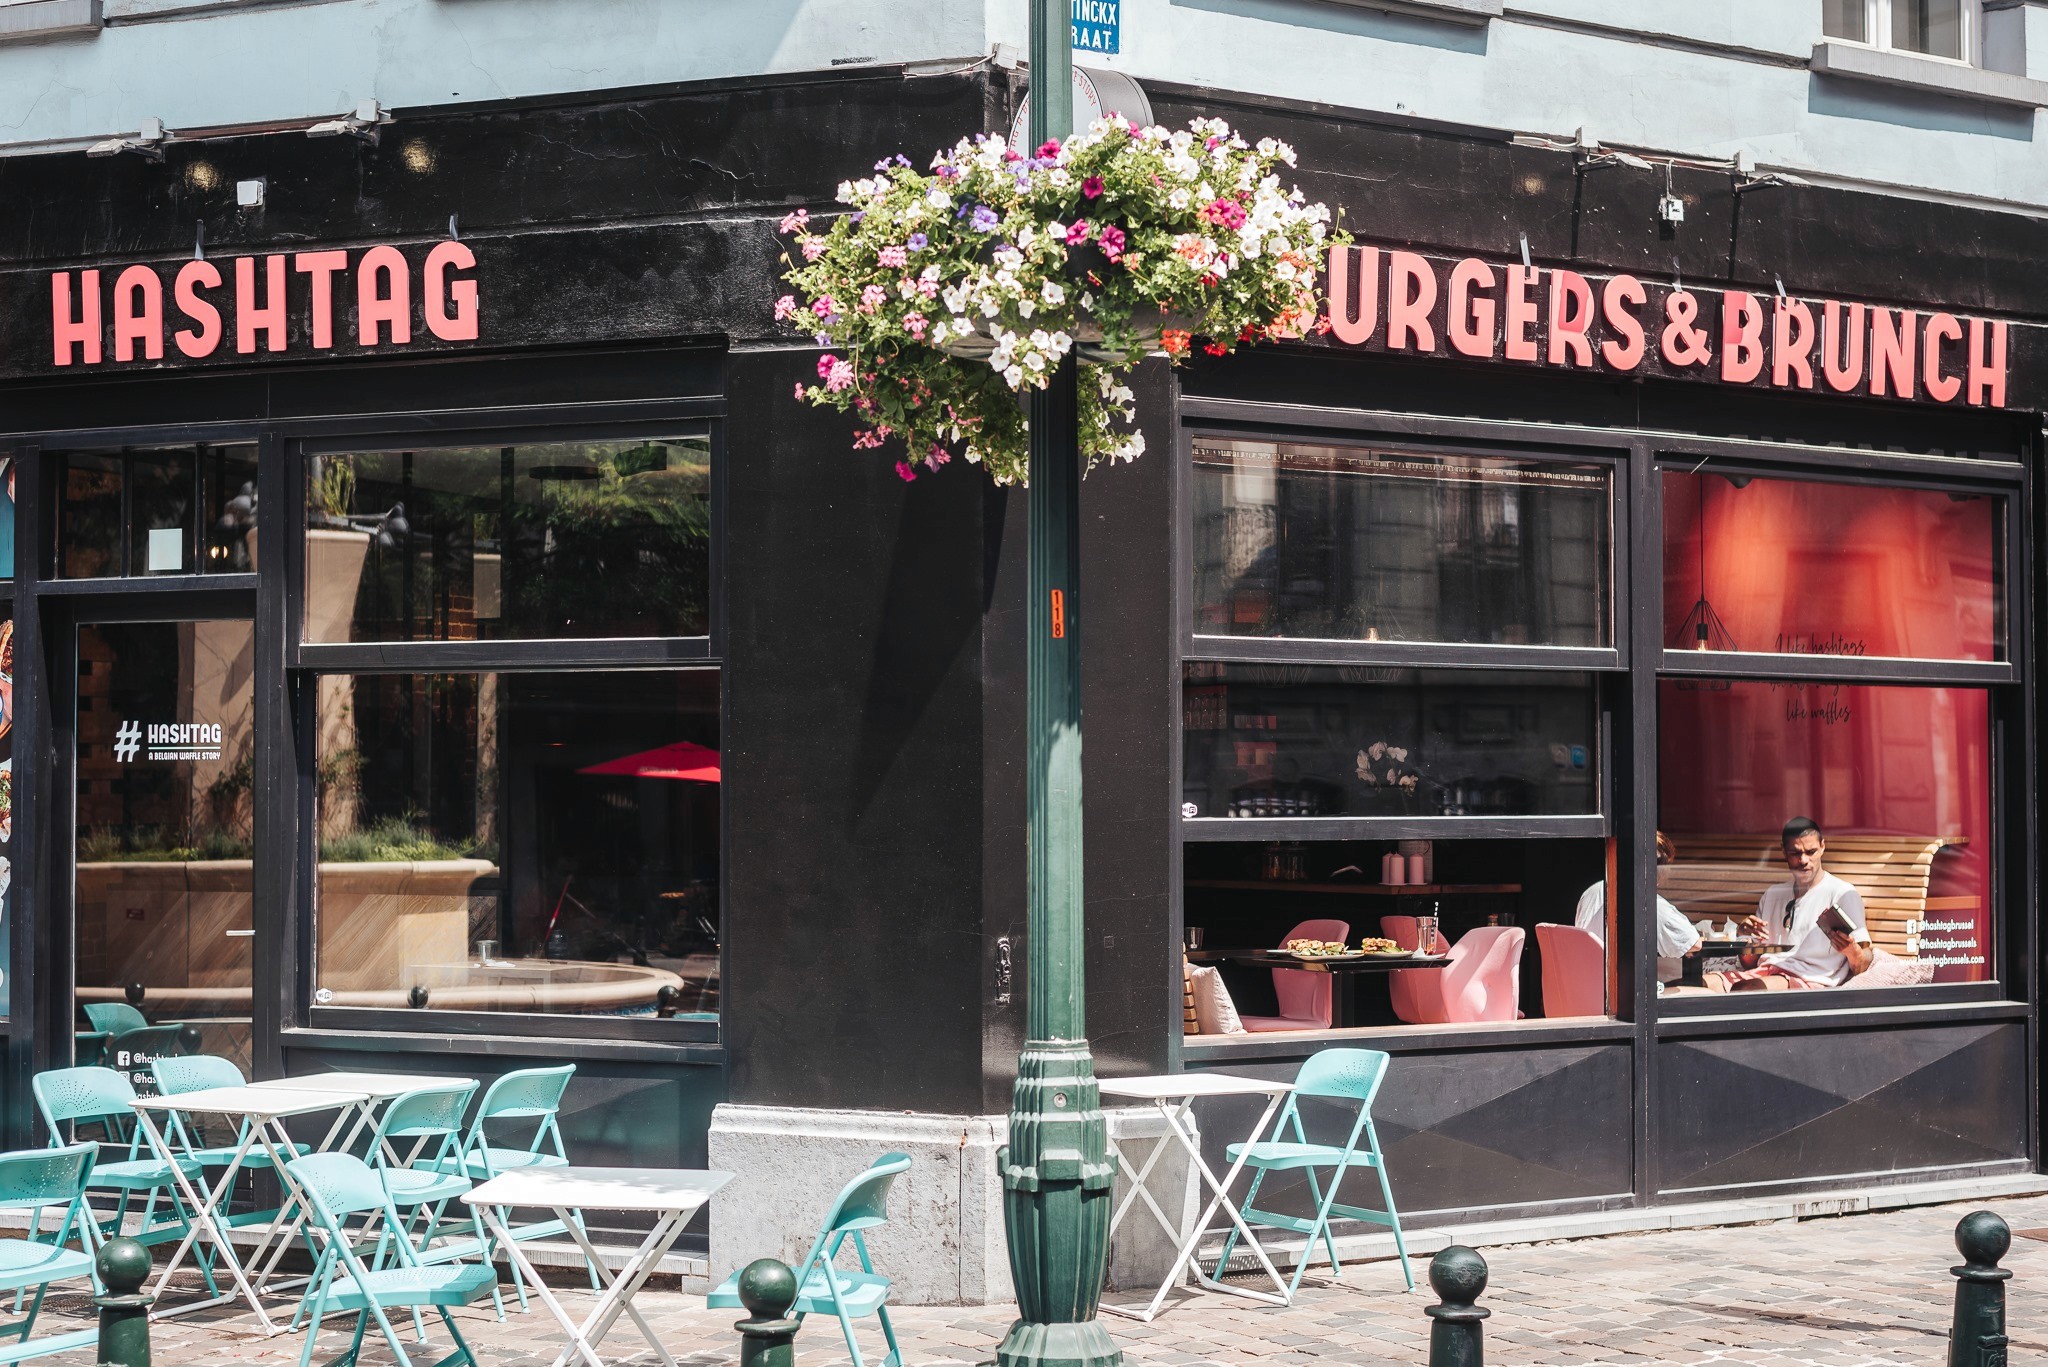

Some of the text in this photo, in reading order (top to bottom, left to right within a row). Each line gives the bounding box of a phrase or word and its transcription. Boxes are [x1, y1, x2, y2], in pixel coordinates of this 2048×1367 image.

[52, 241, 479, 366] HASHTAG
[1661, 290, 1713, 366] &
[1721, 289, 2008, 408] BRUNCH
[1811, 632, 1867, 656] hashtags
[1786, 699, 1851, 725] like waffles
[148, 723, 222, 744] HASHTAG
[148, 751, 221, 761] A BELGIAN WAFFLE STORY
